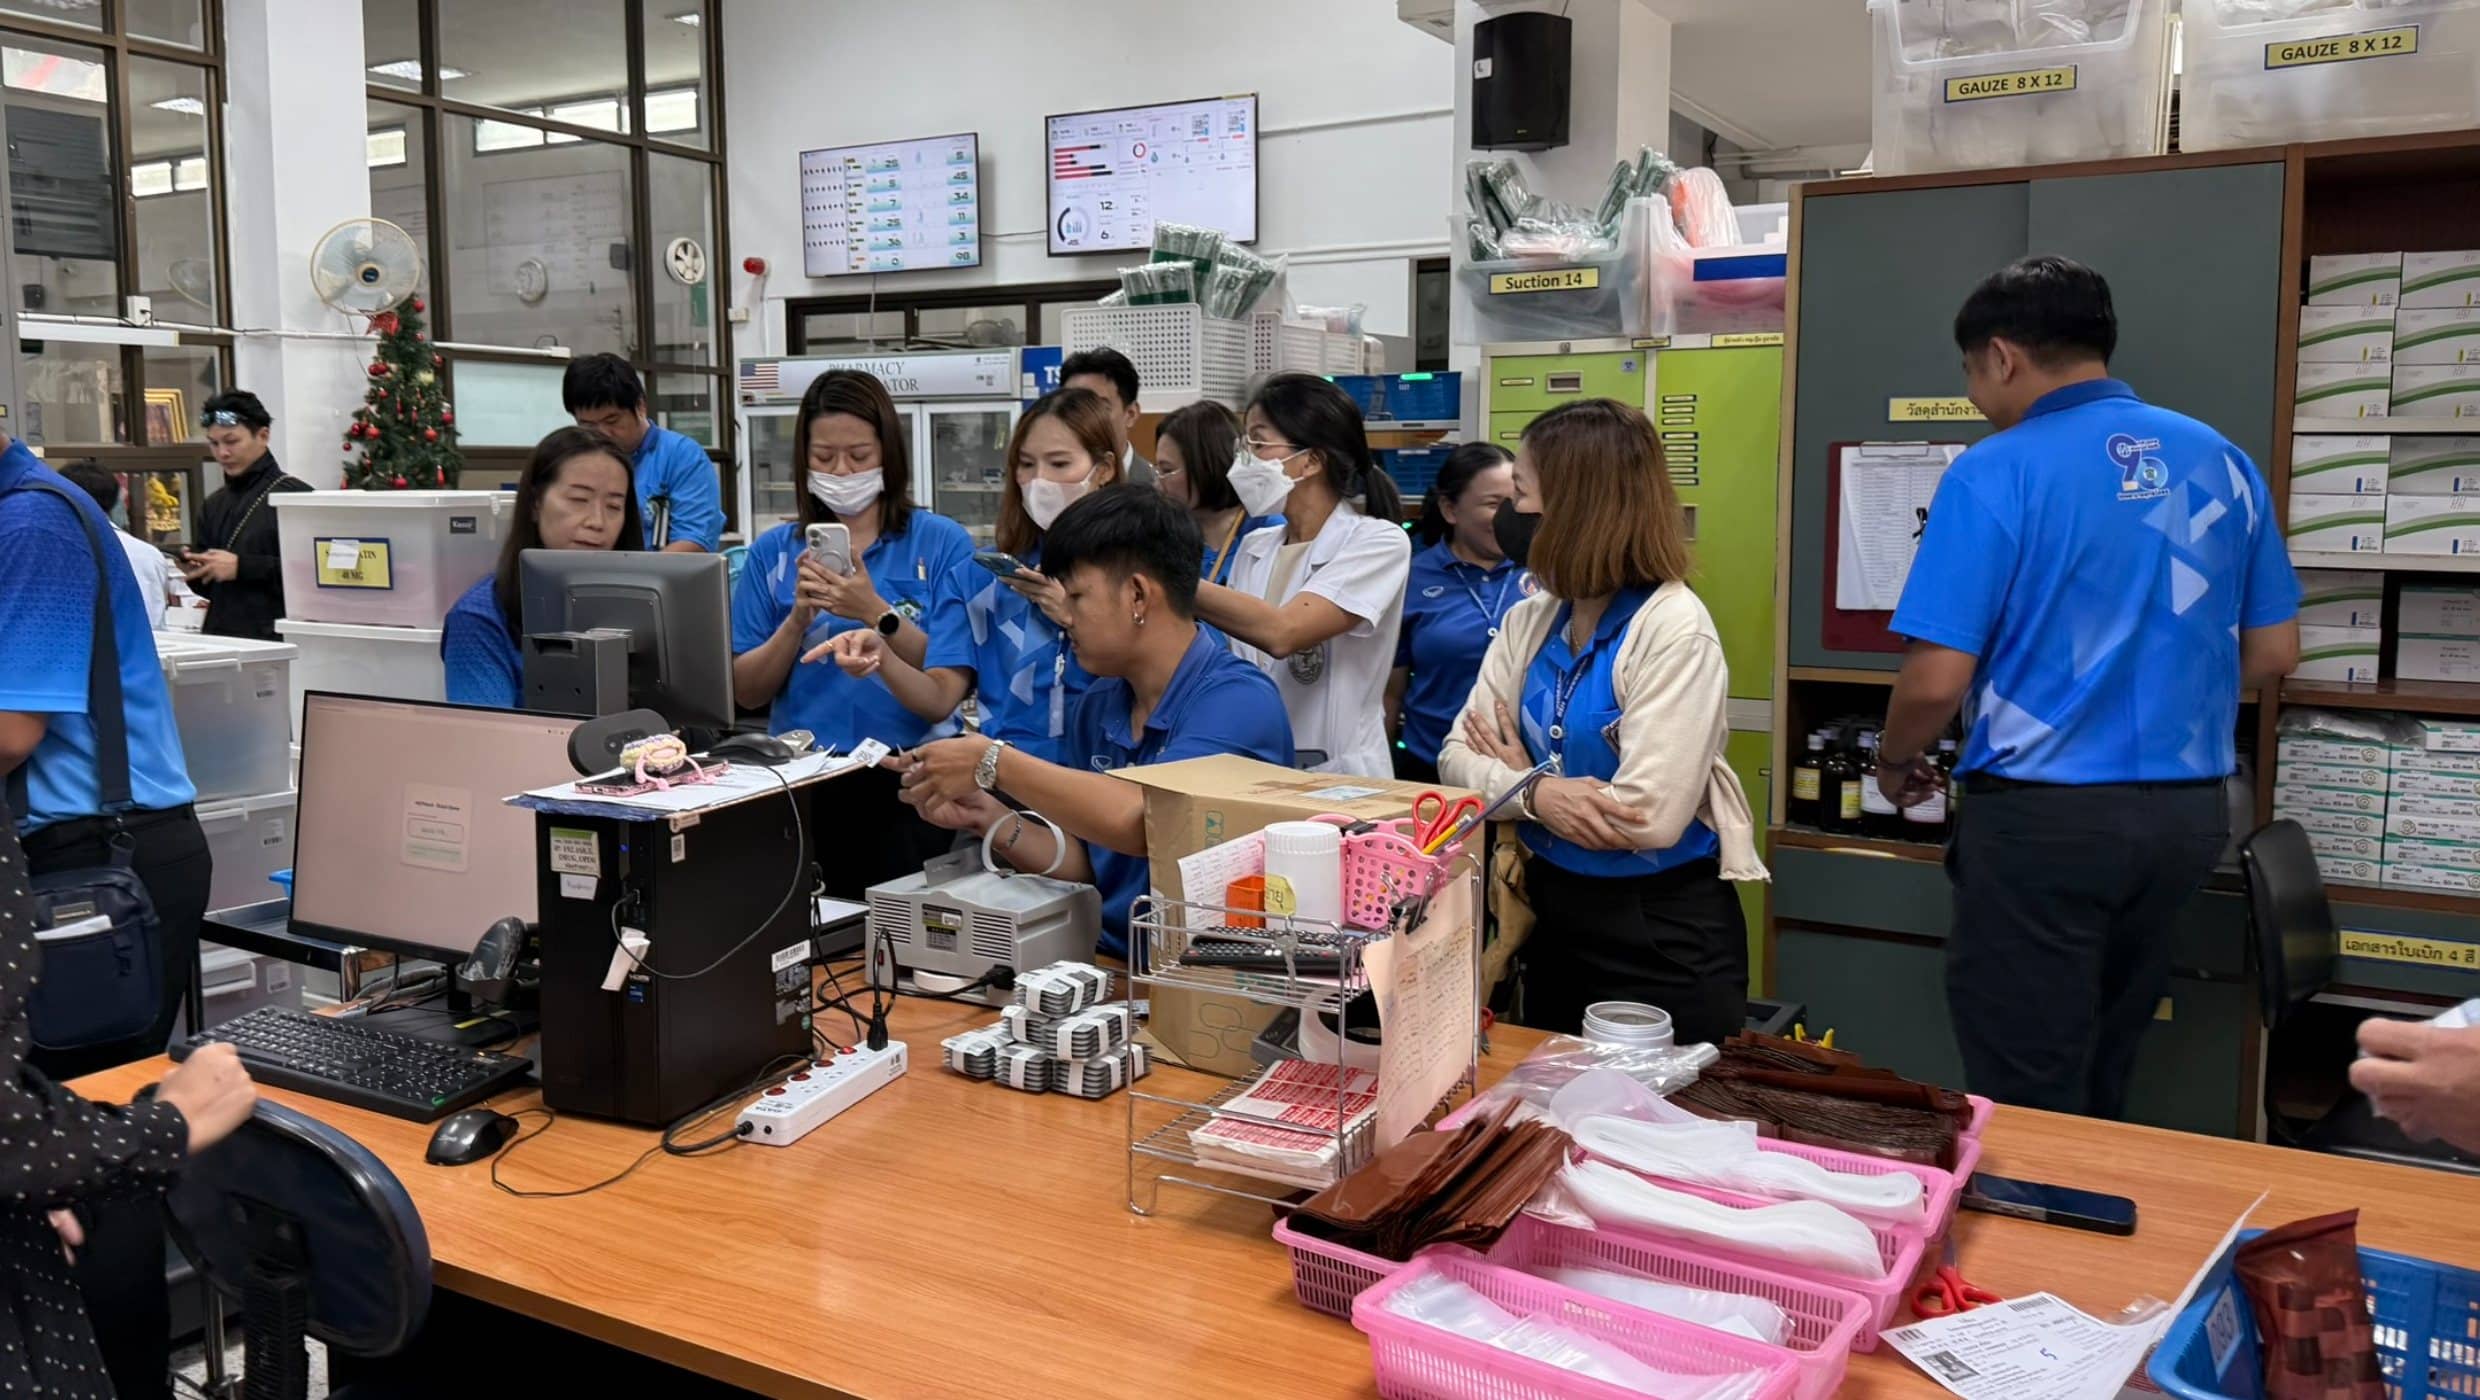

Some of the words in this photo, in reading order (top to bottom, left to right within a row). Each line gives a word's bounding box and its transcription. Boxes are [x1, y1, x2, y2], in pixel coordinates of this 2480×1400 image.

[2281, 42, 2339, 61] GAUZE
[2349, 40, 2359, 54] 8
[2364, 38, 2376, 52] X
[2381, 35, 2402, 50] 12
[1958, 79, 2009, 95] GAUZE
[2017, 77, 2026, 89] 8
[2030, 75, 2040, 88] X
[2044, 73, 2062, 86] 12
[1100, 201, 1113, 210] 12
[1100, 230, 1109, 239] 6
[1505, 274, 1560, 289] Suction
[1565, 272, 1583, 286] 14
[1906, 402, 1983, 420] วัสดุสำนักงา
[2345, 940, 2442, 960] เอกสารใบเบิก
